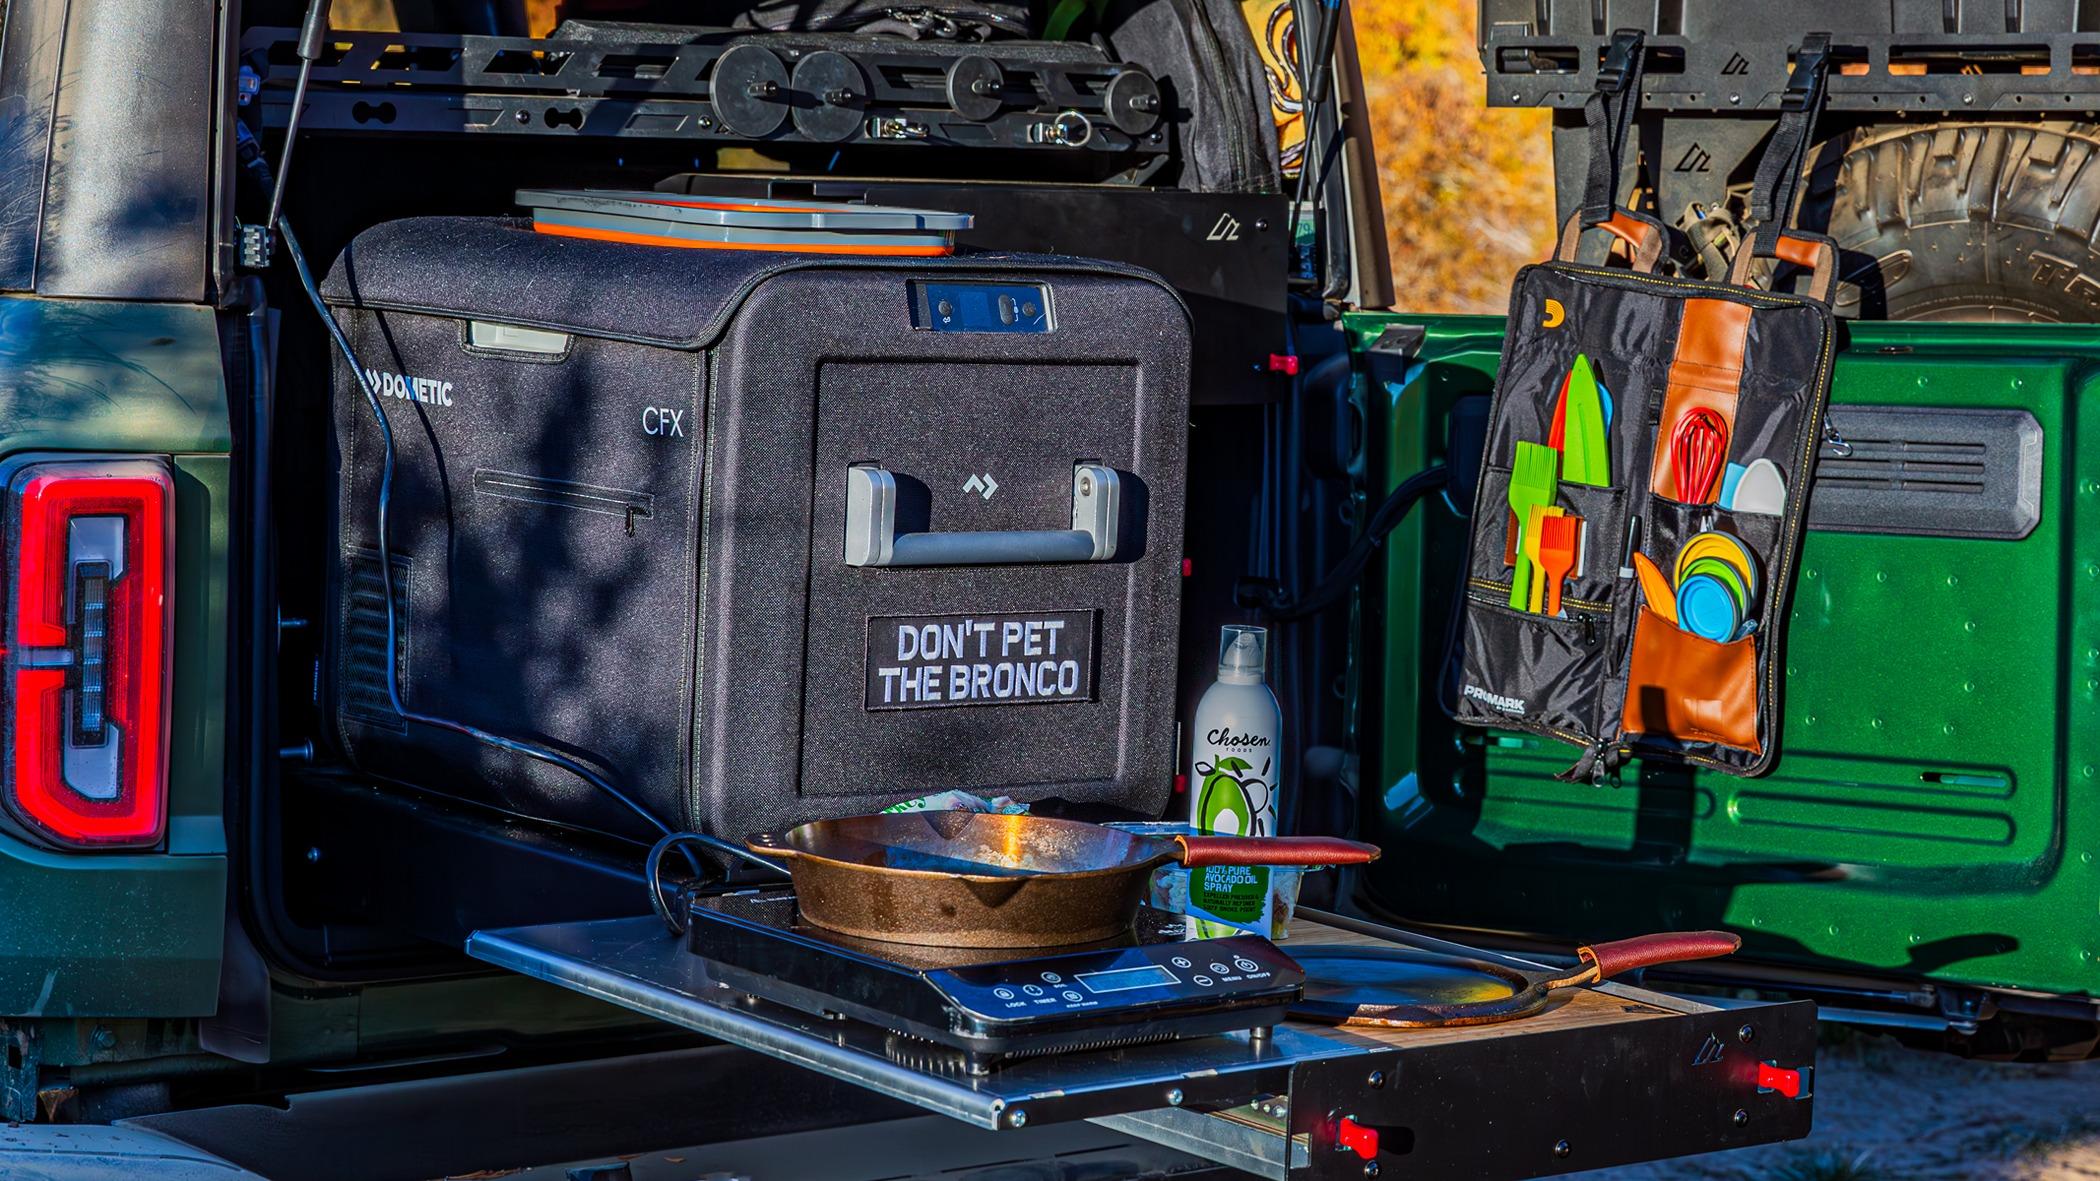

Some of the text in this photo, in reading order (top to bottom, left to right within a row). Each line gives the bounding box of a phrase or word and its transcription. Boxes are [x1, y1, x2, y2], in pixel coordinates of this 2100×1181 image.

[382, 372, 453, 407] DOMETIC
[643, 406, 684, 437] CFX
[898, 619, 1065, 661] DON'T PET
[878, 660, 1079, 703] THE BRONCO
[1206, 727, 1271, 747] Chosen
[1204, 873, 1244, 884] AVOCADO
[1228, 865, 1251, 876] PURE
[1203, 881, 1234, 893] SPRAY
